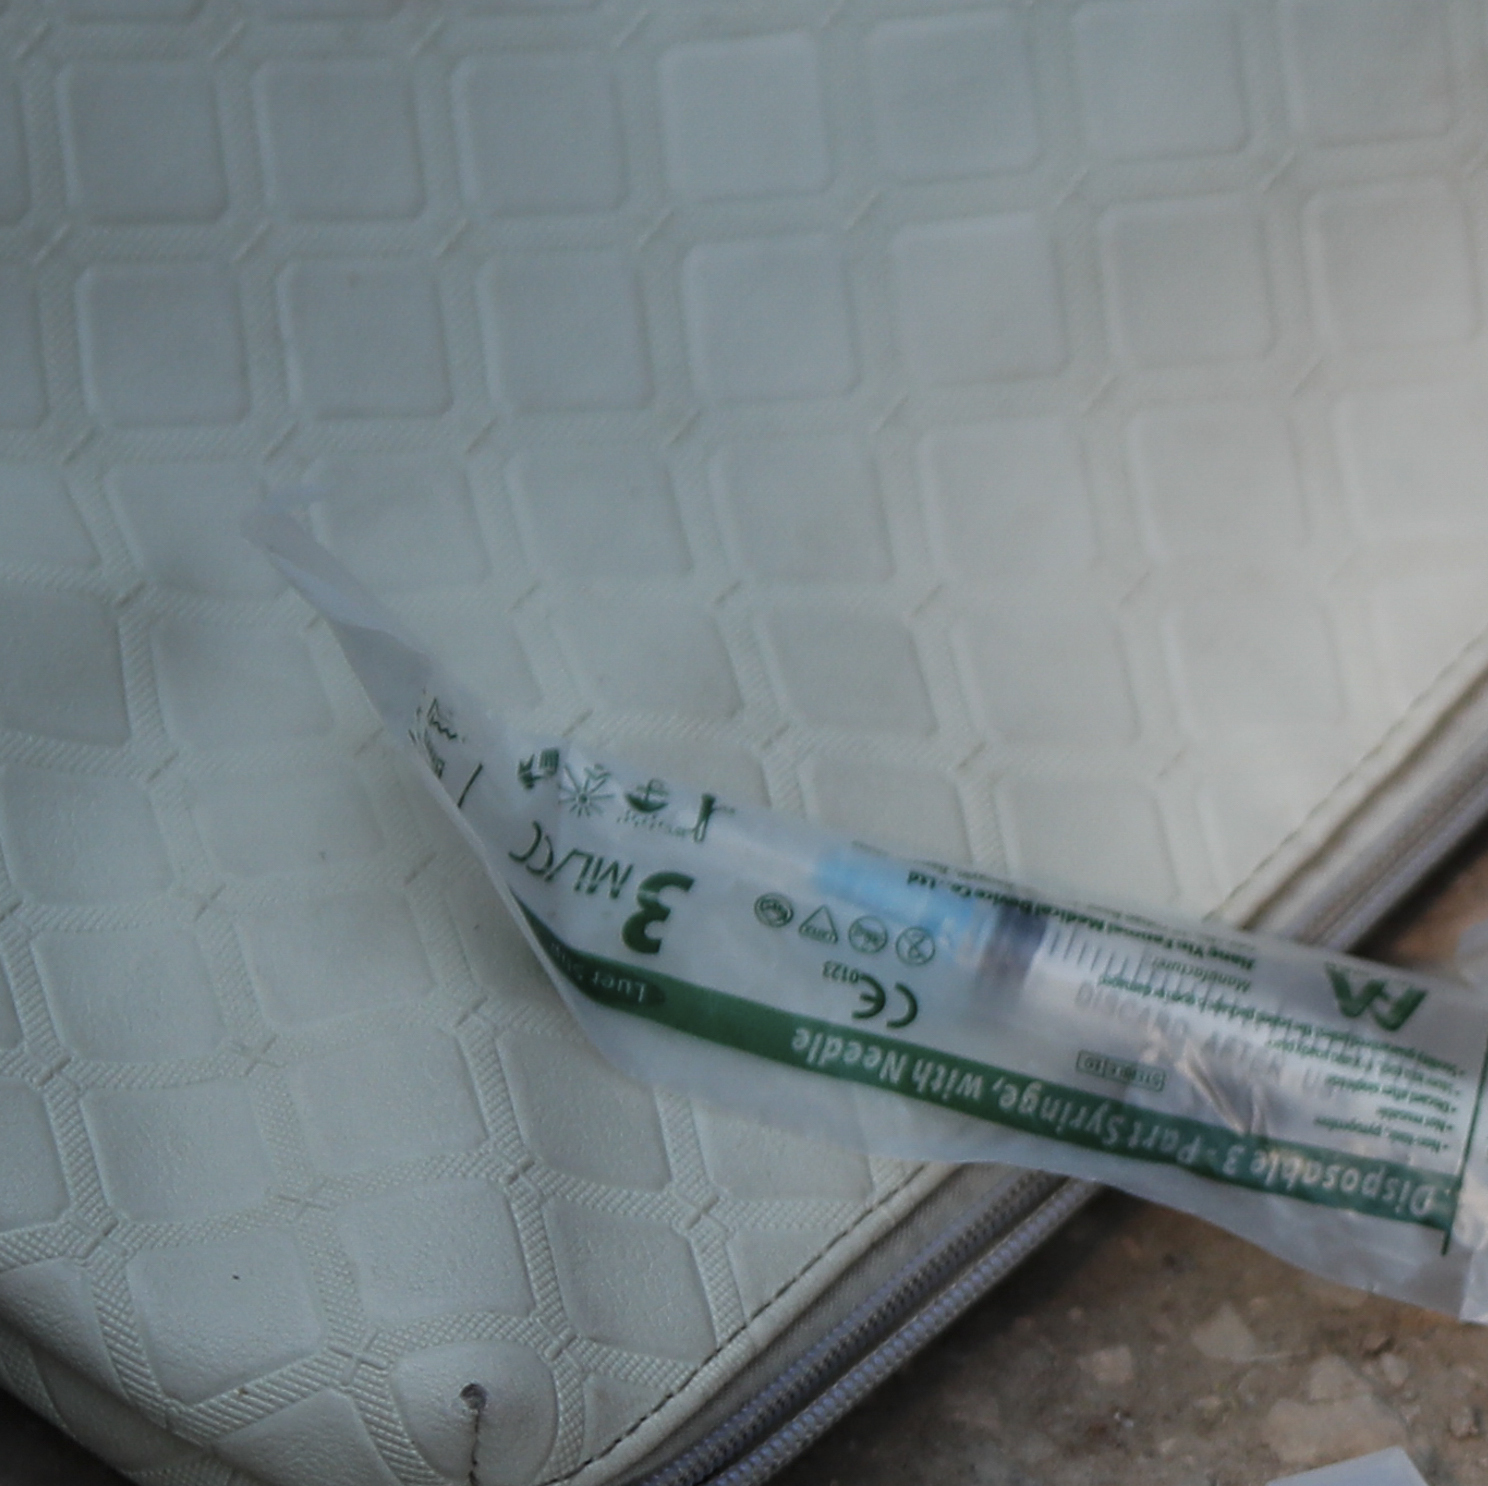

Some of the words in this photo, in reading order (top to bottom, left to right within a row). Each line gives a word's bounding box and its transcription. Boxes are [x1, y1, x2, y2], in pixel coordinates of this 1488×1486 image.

[615, 861, 694, 962] 3
[820, 959, 861, 984] 0123
[786, 1024, 908, 1086] Needle
[905, 1055, 986, 1109] with
[986, 1073, 1125, 1142] Syringe,
[1254, 1148, 1438, 1215] Disposable
